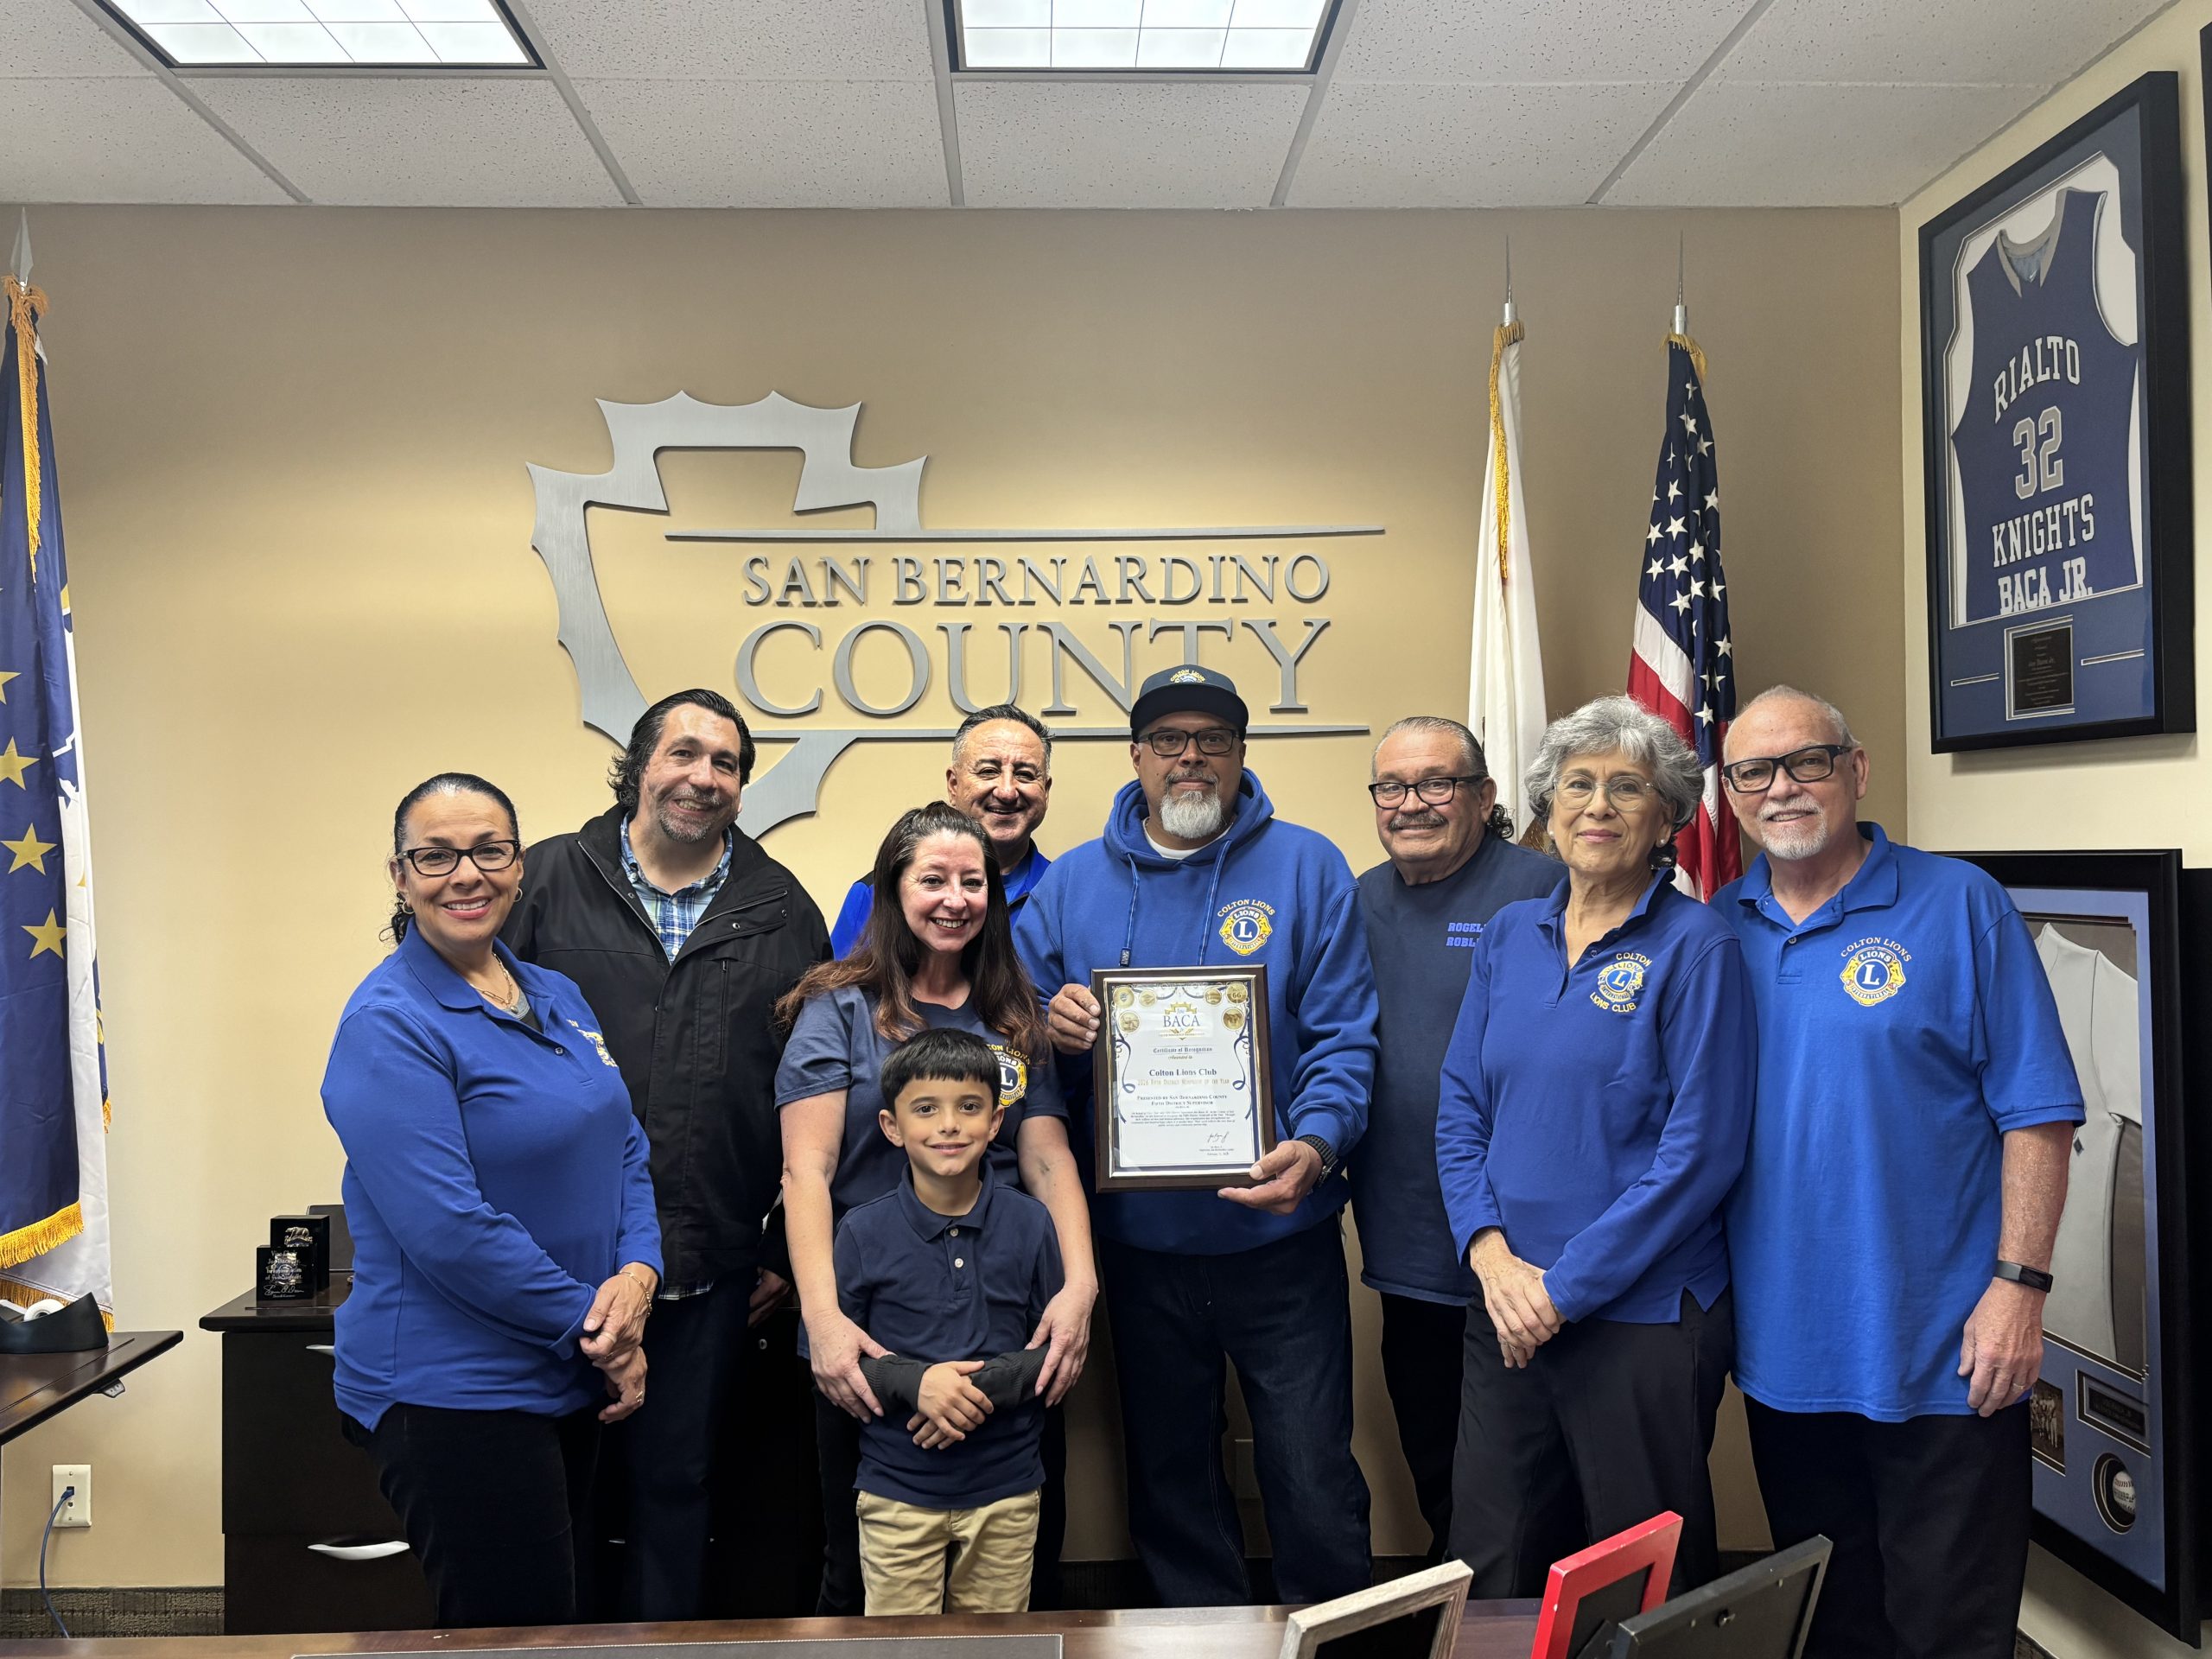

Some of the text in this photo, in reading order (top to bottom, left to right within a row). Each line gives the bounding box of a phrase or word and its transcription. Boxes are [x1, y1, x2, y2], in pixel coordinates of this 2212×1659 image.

[1993, 335, 2080, 423] RIALTO
[2013, 405, 2064, 499] 32
[1993, 493, 2095, 567] KNIGHTS
[742, 554, 1330, 606] SAN BERNARDINO
[1998, 556, 2094, 615] BACA JR.
[735, 618, 1332, 717] COUNTY
[1217, 899, 1275, 917] COLTON LIONS
[1233, 909, 1260, 919] LIONS
[1237, 920, 1253, 938] L
[1447, 922, 1486, 933] ROGEL
[1840, 937, 1912, 962] COLTON LIONS
[1859, 950, 1892, 963] LIONS
[1616, 952, 1653, 967] COLTON
[1611, 970, 1627, 988] L
[1861, 963, 1880, 986] L
[1611, 1002, 1637, 1013] CLUB
[1163, 1014, 1201, 1027] BACA
